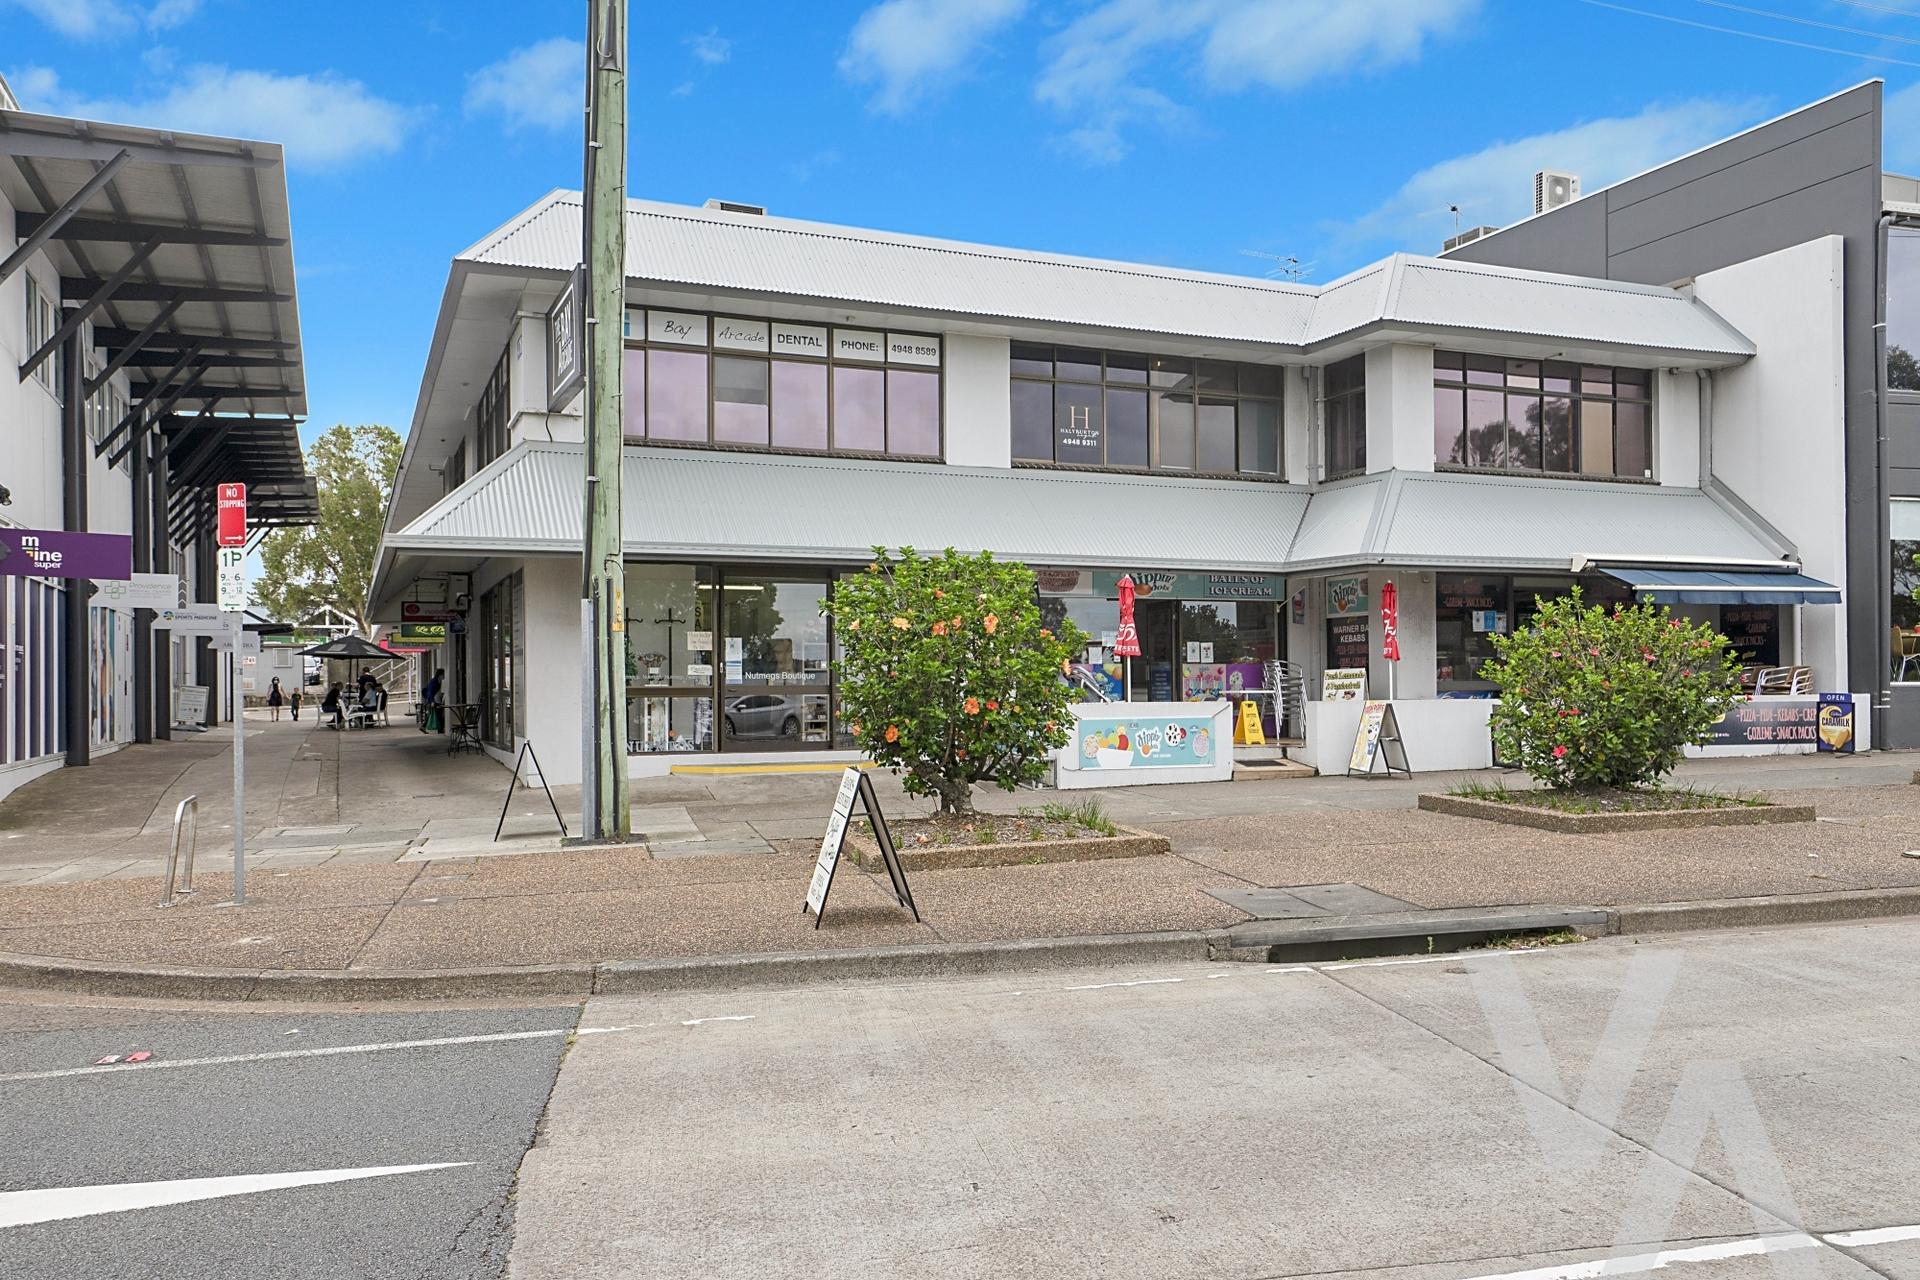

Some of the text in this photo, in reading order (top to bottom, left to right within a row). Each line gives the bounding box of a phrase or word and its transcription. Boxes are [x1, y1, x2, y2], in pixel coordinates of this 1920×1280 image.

[664, 320, 937, 356] Bay Arcade DENTAL PHONE: 4948 8589
[1070, 406, 1089, 429] H
[226, 487, 238, 497] NO
[219, 499, 245, 509] STOPPING
[223, 551, 242, 567] 1P
[33, 561, 62, 570] super
[1209, 574, 1248, 584] BALLS
[1250, 575, 1265, 584] OF
[1332, 624, 1360, 634] WARNER
[1340, 633, 1366, 643] KEBABS
[745, 671, 816, 682] Nutmegs Boutique
[1821, 716, 1850, 728] CARAMILK
[1797, 725, 1817, 740] PACKS
